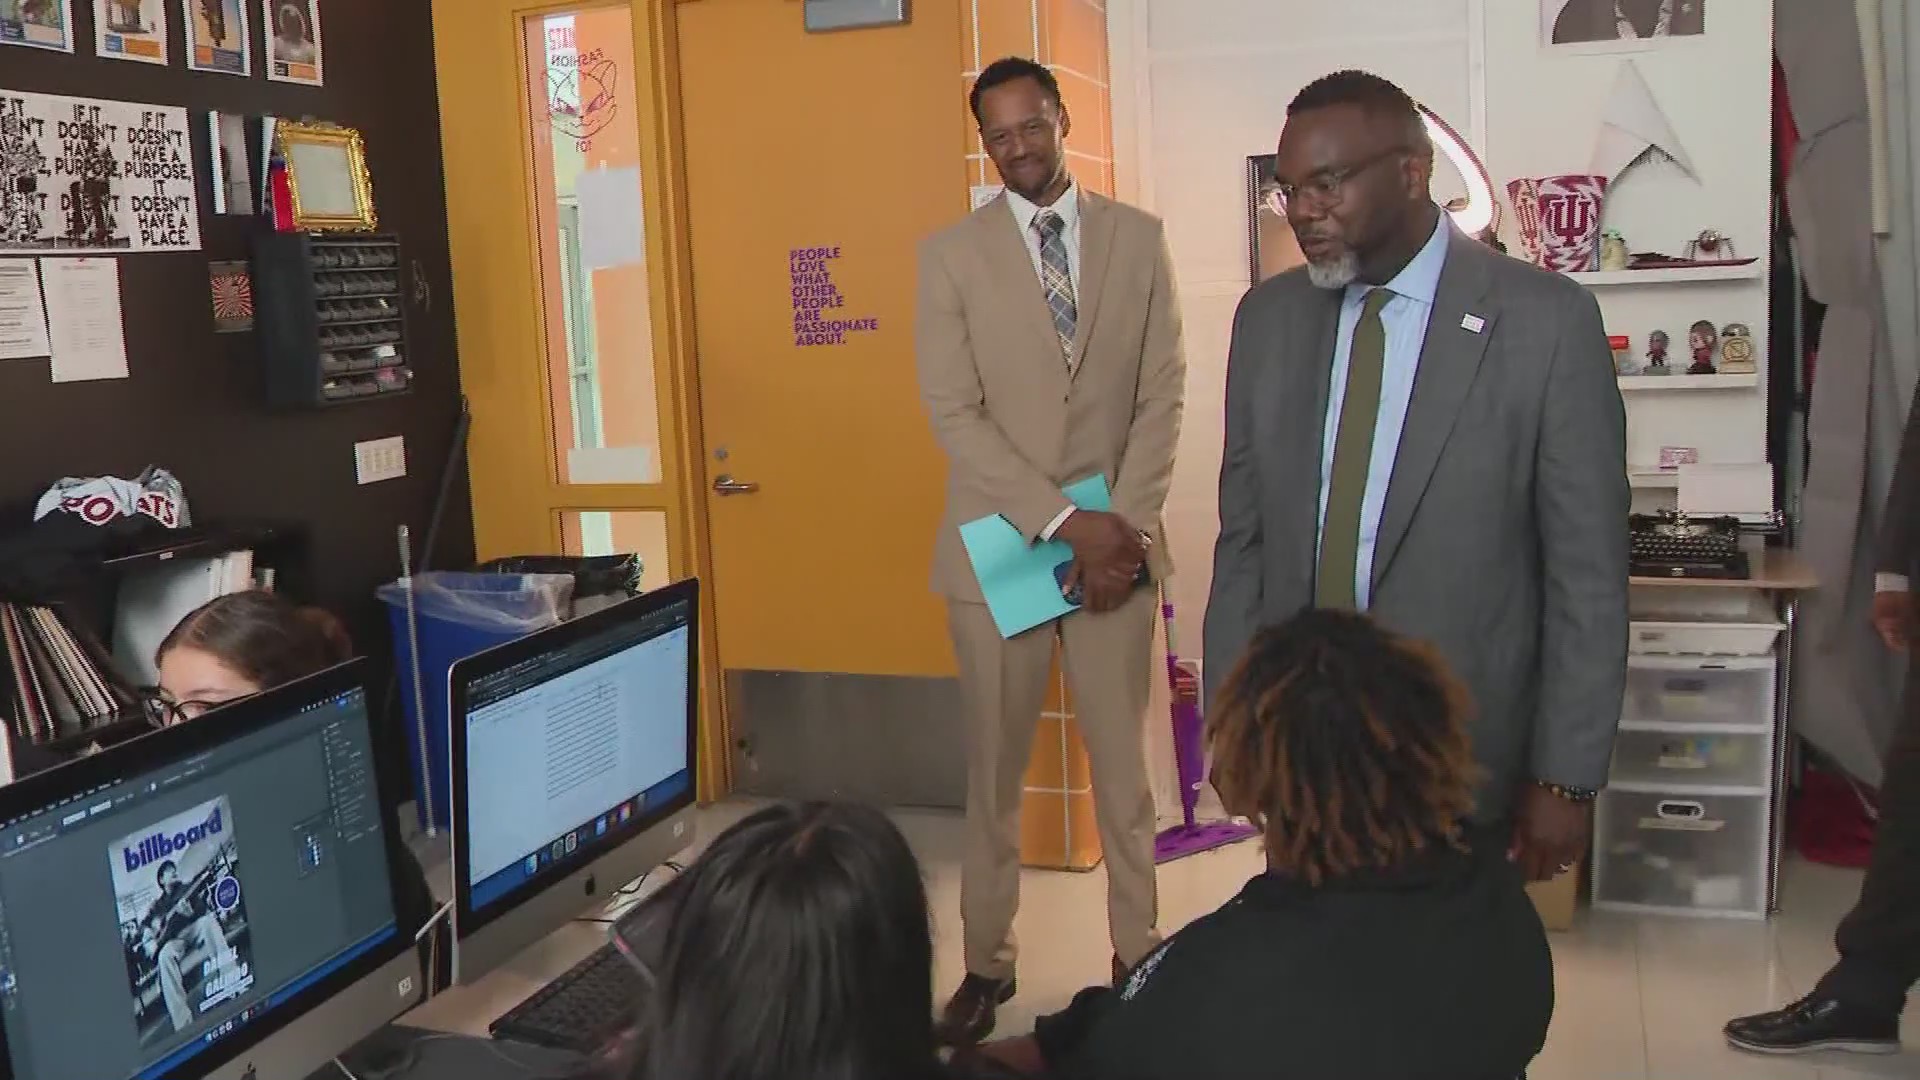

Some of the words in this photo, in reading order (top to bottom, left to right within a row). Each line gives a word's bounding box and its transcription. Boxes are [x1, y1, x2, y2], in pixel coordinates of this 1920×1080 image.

[73, 104, 85, 122] IF
[88, 106, 101, 123] IT
[142, 112, 153, 129] IF
[155, 112, 167, 129] IT
[127, 126, 184, 147] DOESN'T
[131, 143, 168, 162] HAVE
[171, 149, 182, 162] A
[124, 161, 193, 182] PURPOSE,
[153, 179, 167, 196] IT
[131, 195, 191, 213] DOESN'T
[138, 212, 176, 229] HAVE
[179, 214, 189, 229] A
[141, 228, 191, 246] PLACE.
[790, 247, 841, 261] PEOPLE
[790, 260, 827, 273] LOVE
[791, 272, 831, 285] WHAT
[792, 284, 837, 298] OTHER
[793, 295, 845, 309] PEOPLE
[794, 309, 822, 322] ARE
[795, 318, 879, 334] PASSIONATE
[795, 332, 847, 347] ABOUT.
[123, 805, 223, 873] billboard
